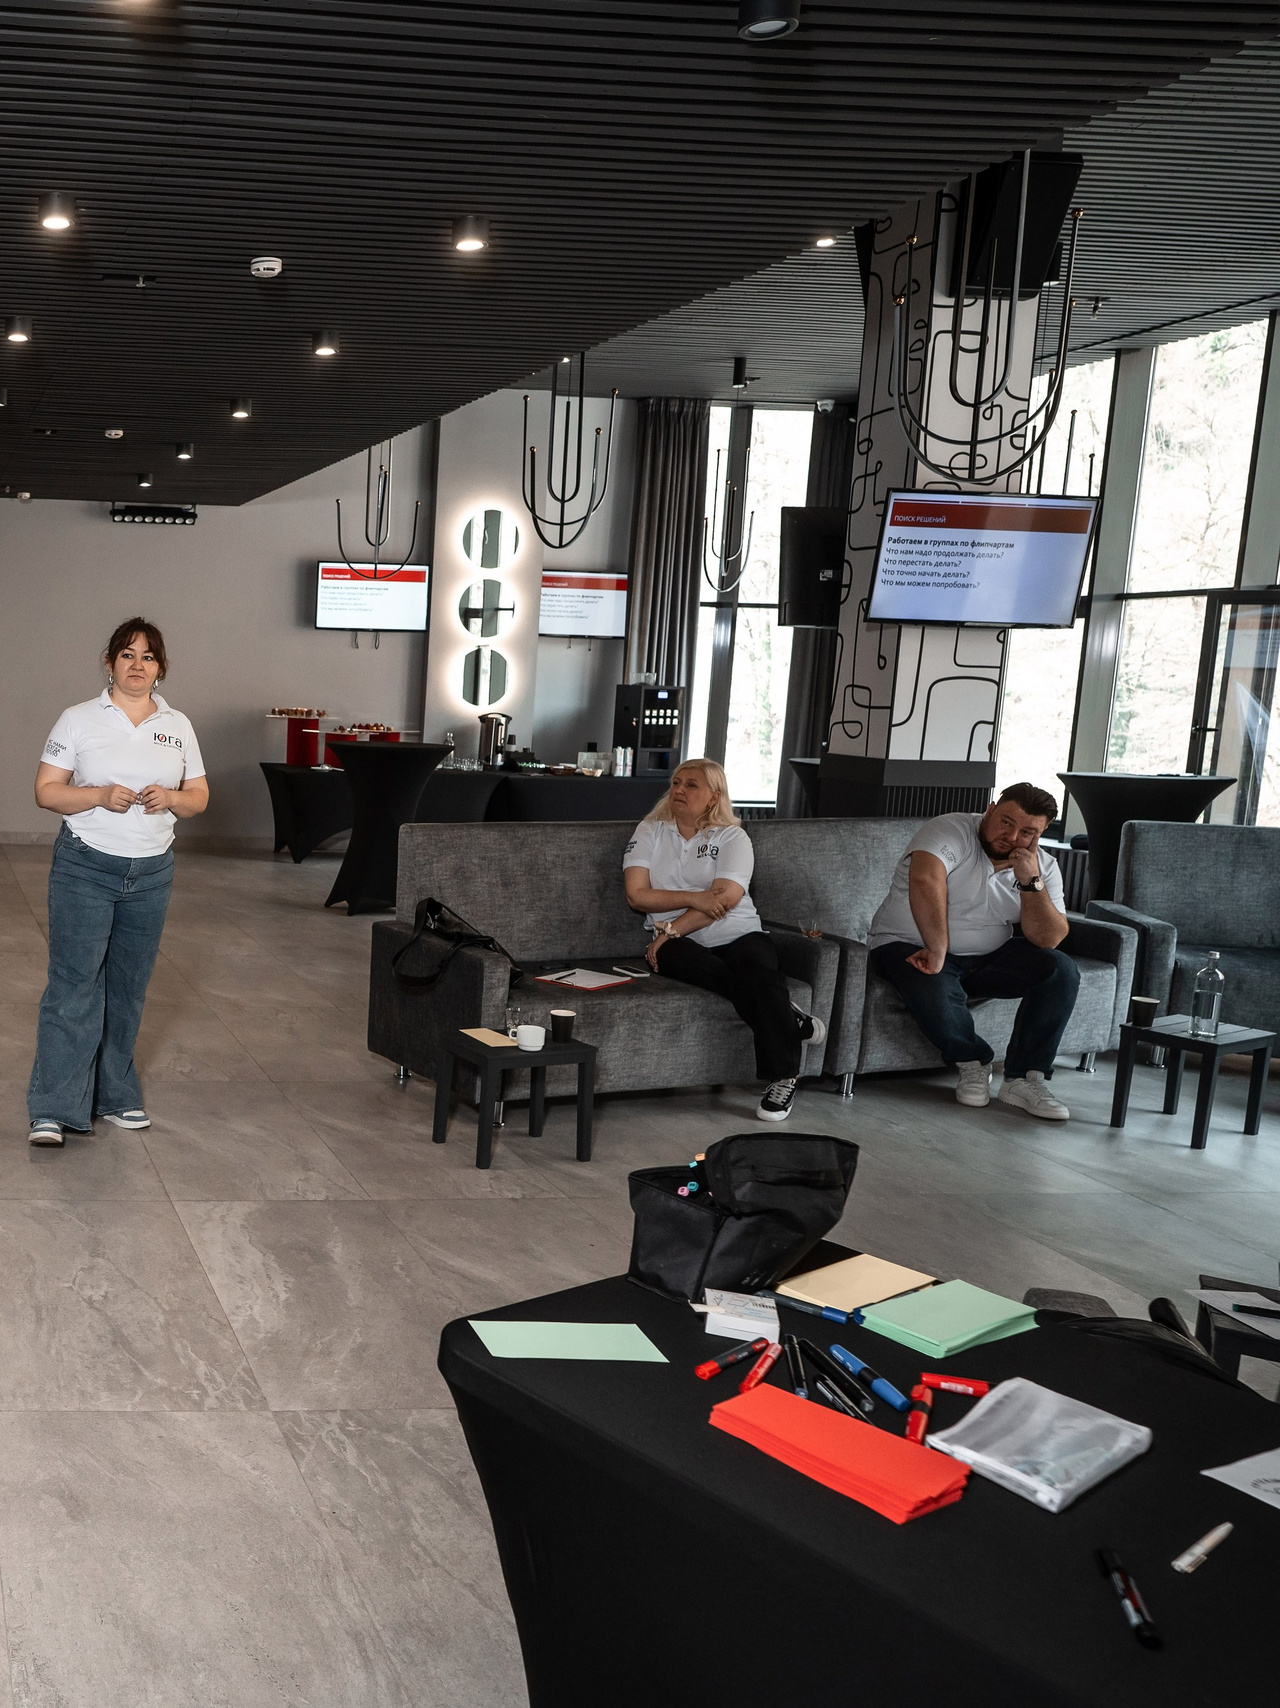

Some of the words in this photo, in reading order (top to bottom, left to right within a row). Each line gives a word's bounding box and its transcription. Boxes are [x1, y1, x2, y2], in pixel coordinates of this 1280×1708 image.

[888, 536, 922, 546] Работаем
[930, 540, 958, 548] группах
[970, 540, 1014, 549] флипчартам
[914, 550, 932, 558] надо
[933, 550, 976, 558] продолжать
[934, 560, 962, 568] делать?
[882, 568, 895, 576] Что
[880, 578, 894, 586] Что
[932, 582, 980, 590] попробовать?
